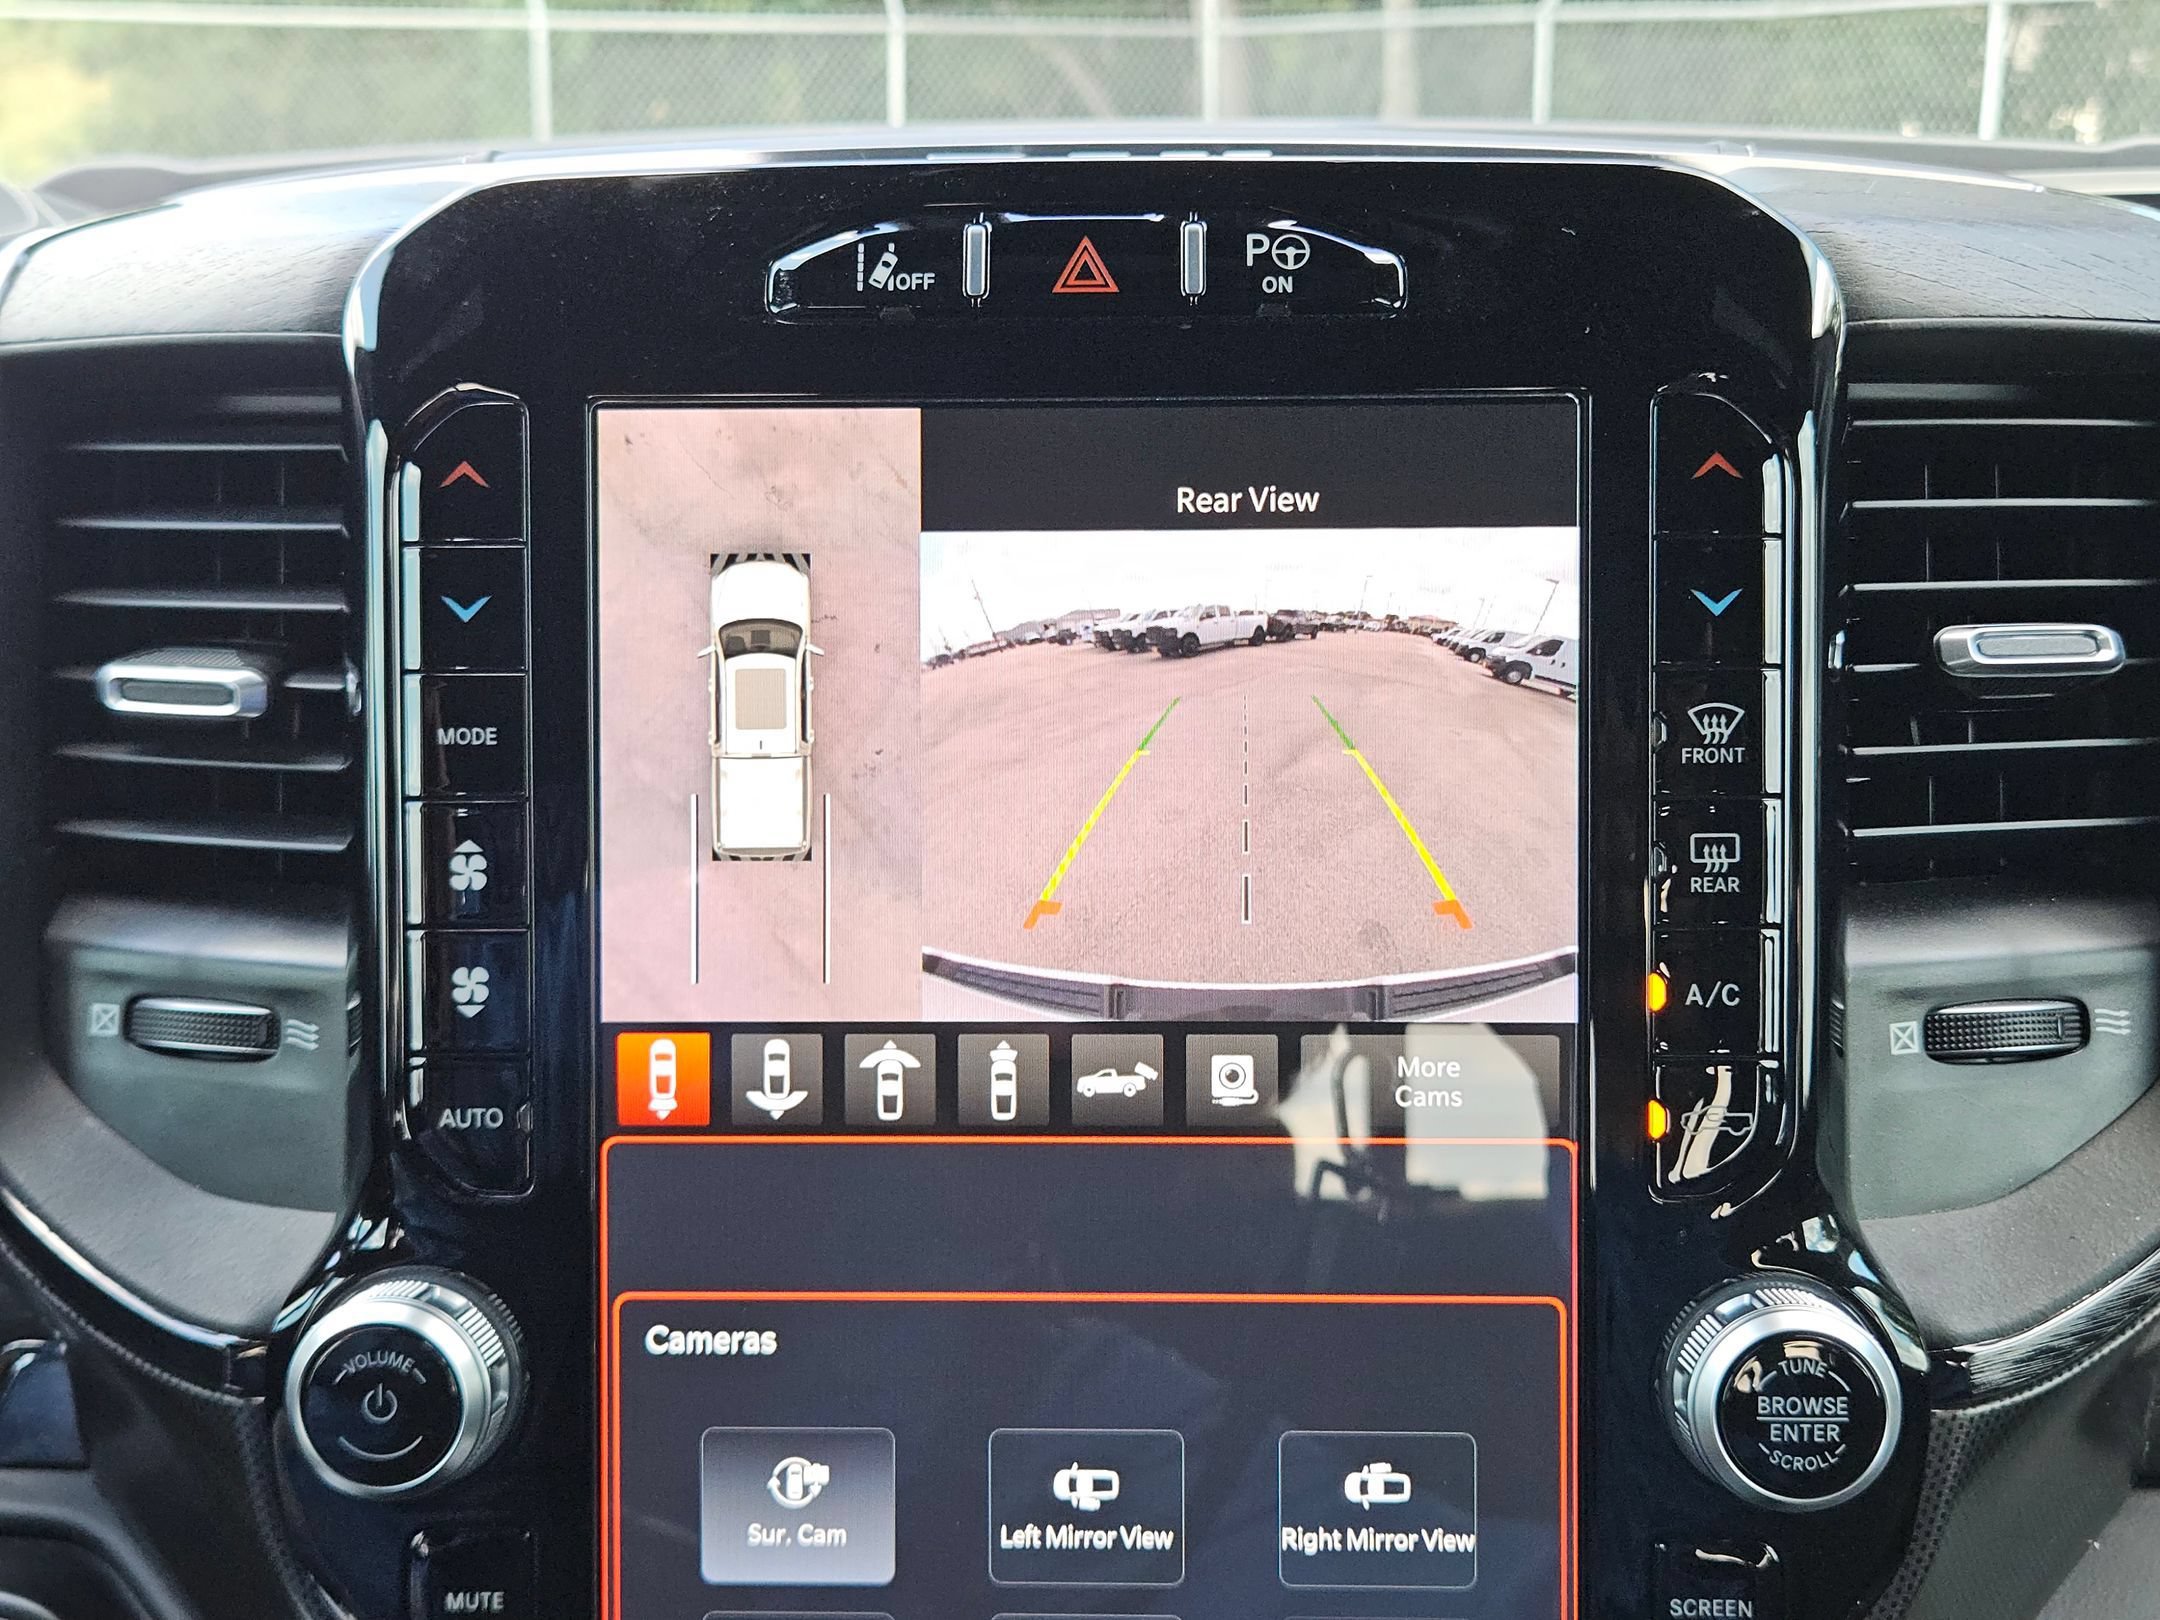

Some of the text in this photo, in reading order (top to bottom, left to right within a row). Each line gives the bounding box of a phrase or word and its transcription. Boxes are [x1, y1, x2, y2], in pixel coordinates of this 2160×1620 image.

[1246, 233, 1270, 267] P
[895, 273, 936, 291] OFF
[1261, 276, 1295, 294] ON
[1175, 484, 1320, 514] Rear View
[437, 727, 498, 746] MODE
[1681, 747, 1746, 765] FRONT
[1690, 876, 1741, 893] REAR
[1685, 980, 1741, 1007] A/C
[1397, 1055, 1461, 1078] More
[1395, 1084, 1463, 1108] Cams
[437, 1108, 504, 1129] AUTO
[645, 1324, 778, 1356] Cameras
[344, 1350, 414, 1374] VOLUME
[1777, 1358, 1829, 1379] TUNE
[1757, 1395, 1849, 1415] BROWSE
[1769, 1423, 1841, 1443] ENTER
[1769, 1449, 1839, 1472] SCROLL
[797, 1523, 847, 1547] Cam
[1000, 1524, 1174, 1551] Left Mirror View
[1281, 1526, 1476, 1556] Right Mirror View
[444, 1591, 505, 1613] MUTE
[1669, 1598, 1753, 1619] SCREEN
